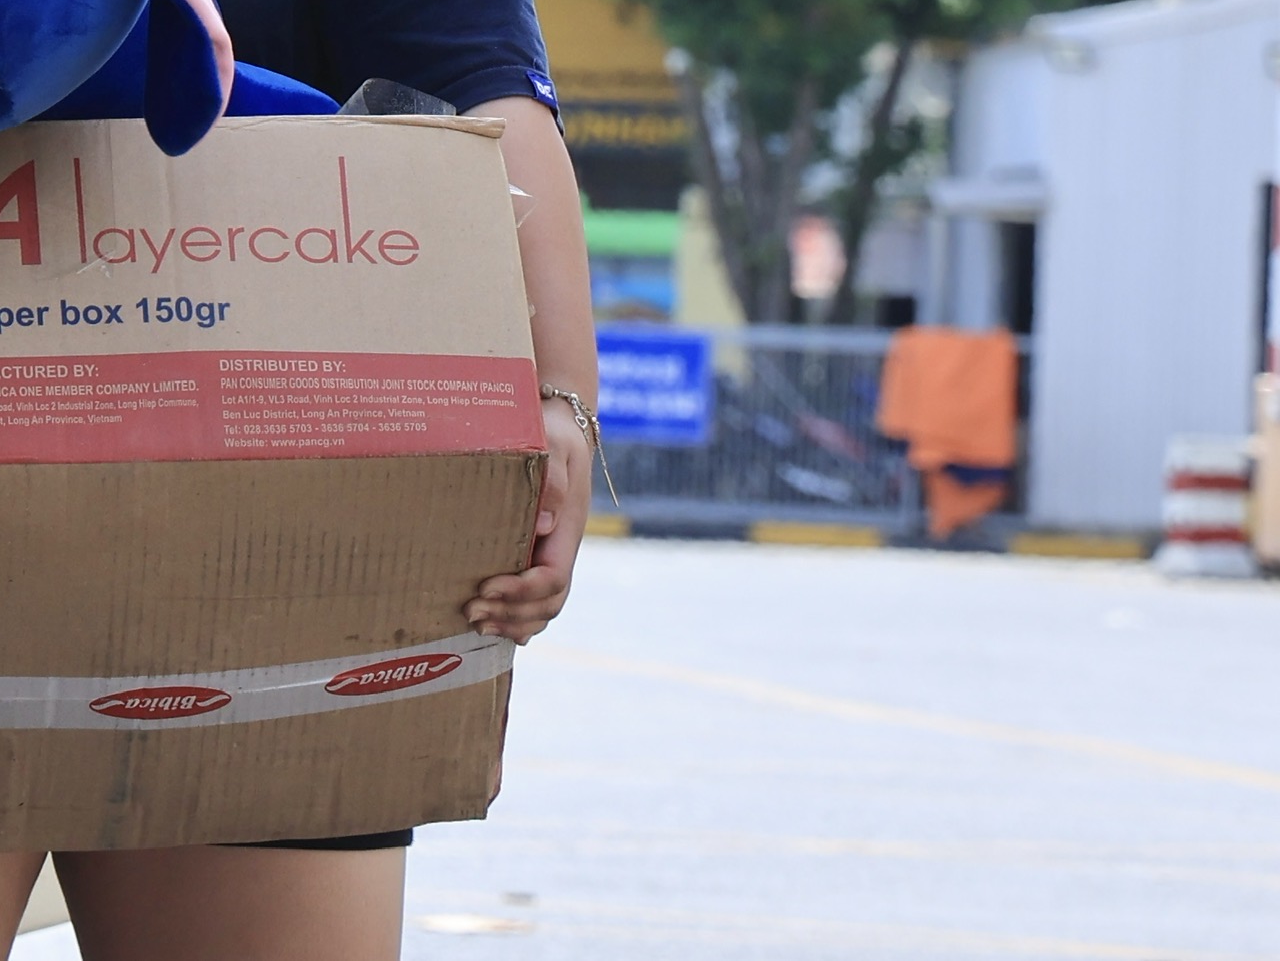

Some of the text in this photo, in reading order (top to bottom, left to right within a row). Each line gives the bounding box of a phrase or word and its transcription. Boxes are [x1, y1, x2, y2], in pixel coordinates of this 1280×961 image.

[73, 156, 420, 274] layercake
[60, 300, 124, 326] box
[135, 296, 230, 329] 150gr
[74, 365, 99, 377] BY:
[220, 359, 346, 373] DISTRIBUTED BY:
[19, 386, 42, 397] ONE
[46, 385, 94, 395] MEMBER
[96, 383, 150, 395] COMPANY
[153, 380, 199, 393] LIMITED.
[221, 377, 514, 395] PAN CONSUMER GOODS DISTRIBUTION JOINT STOCK COMPANY (PANCG)
[16, 402, 33, 411] Vinh
[35, 402, 49, 411] Loc
[51, 402, 56, 410] 2
[58, 401, 93, 411] Industrial
[95, 401, 116, 410] Zone,
[118, 400, 138, 410] Long
[158, 398, 200, 407] Commune,
[222, 395, 236, 404] Lot
[268, 395, 285, 403] VL3
[287, 395, 312, 405] Road,
[314, 395, 332, 403] Vinh
[335, 395, 350, 403] Loc
[352, 395, 358, 403] 2
[360, 395, 399, 404] Industrial
[402, 395, 425, 405] Zone,
[427, 396, 448, 406] Long
[451, 397, 470, 407] Hiep
[472, 397, 518, 408] Commune,
[8, 417, 30, 426] Long
[32, 416, 44, 425] An
[46, 415, 86, 425] Province,
[88, 415, 122, 423] Vietnam
[223, 409, 426, 419] Ben Luc District, Long An Province, Vietnam
[224, 425, 240, 435] Tel:
[244, 424, 286, 434] 028.3636
[290, 424, 312, 433] 5703
[322, 423, 344, 433] 3636
[346, 423, 370, 433] 5704
[378, 423, 402, 431] 3636
[404, 423, 427, 431] 5705
[224, 438, 344, 448] Website: www.pancg.vn
[359, 661, 428, 685] Bibica
[124, 694, 198, 712] Bibica
